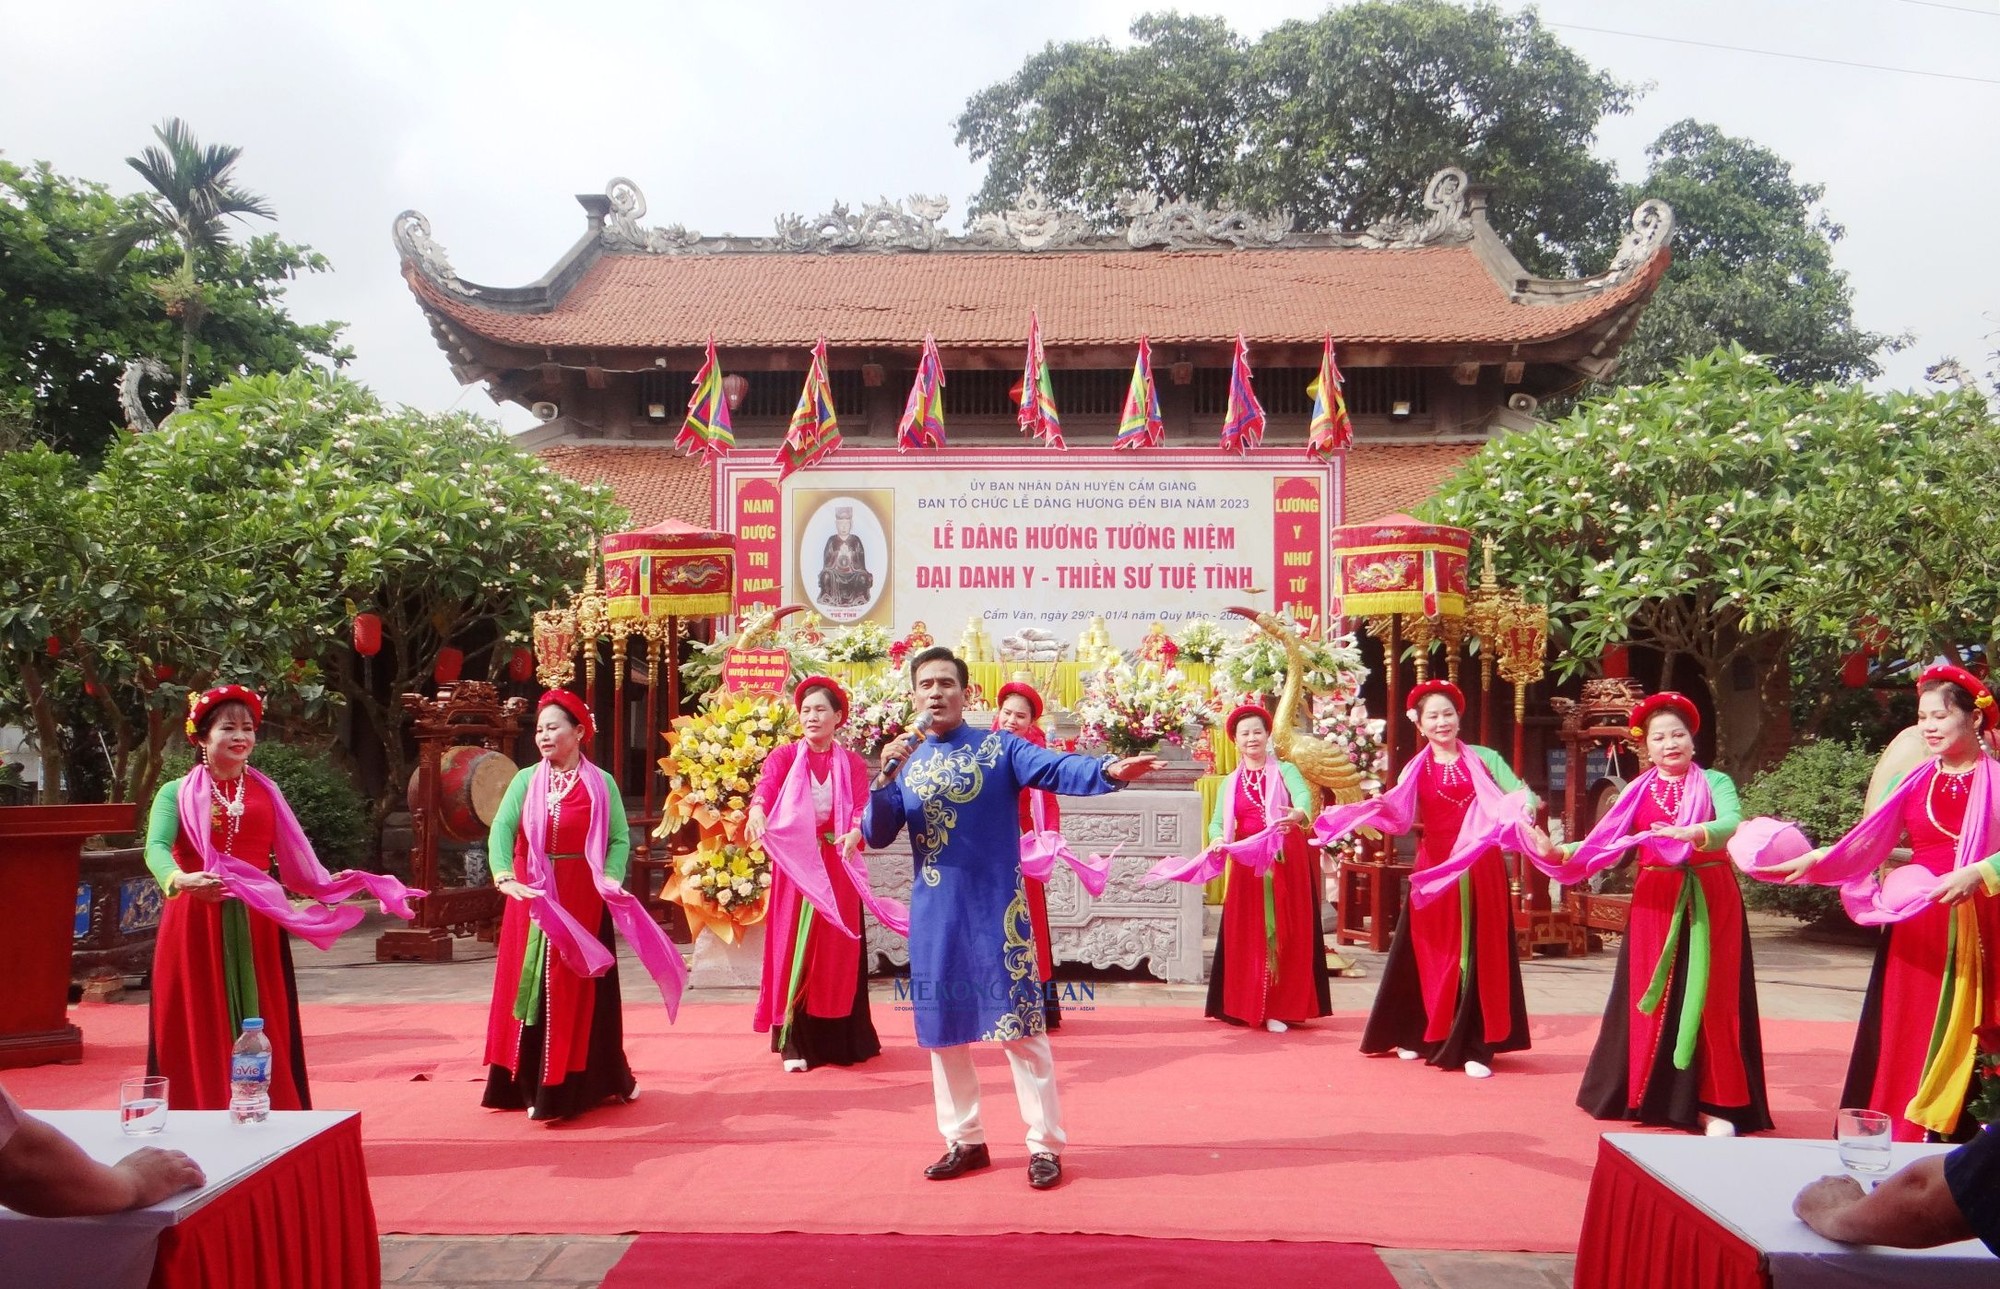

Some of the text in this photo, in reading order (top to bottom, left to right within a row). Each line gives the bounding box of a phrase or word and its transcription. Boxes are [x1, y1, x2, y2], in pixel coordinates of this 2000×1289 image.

[970, 477, 1197, 492] ỦY BAN NHÂN DÂN HUYỆN CẨM GIÀNG
[743, 499, 774, 513] NAM
[918, 498, 945, 509] BAN
[950, 493, 968, 509] TỔ
[971, 496, 1009, 509] CHỨC
[1013, 493, 1030, 509] LỄ
[1034, 496, 1072, 509] DÂNG
[1076, 497, 1124, 509] HƯƠNG
[1160, 498, 1182, 509] BIA
[1186, 496, 1216, 509] NĂM
[1220, 498, 1250, 509] 2023
[1275, 497, 1319, 513] LƯƠNG
[741, 524, 776, 542] DƯỢC
[933, 519, 1235, 553] LỄ DÂNG HƯƠNG TƯỞNG NIỆM
[1292, 525, 1302, 540] Y
[748, 552, 768, 569] TRỊ
[1283, 551, 1313, 566] NHƯ
[916, 566, 951, 593] ĐẠI
[959, 566, 1015, 589] DANH
[1022, 566, 1035, 589] Y
[1056, 558, 1116, 589] THIỀN
[1123, 563, 1154, 589] SƯ
[1158, 562, 1197, 593] TUỆ
[1203, 563, 1253, 589] TĨNH
[743, 578, 774, 592] NAM
[1288, 576, 1308, 593] TỪ
[983, 607, 1008, 620] Cẩm
[1040, 610, 1068, 622] ngày
[1105, 610, 1128, 620] 01/4
[1131, 610, 1156, 620] năm
[1160, 610, 1183, 622] Quý
